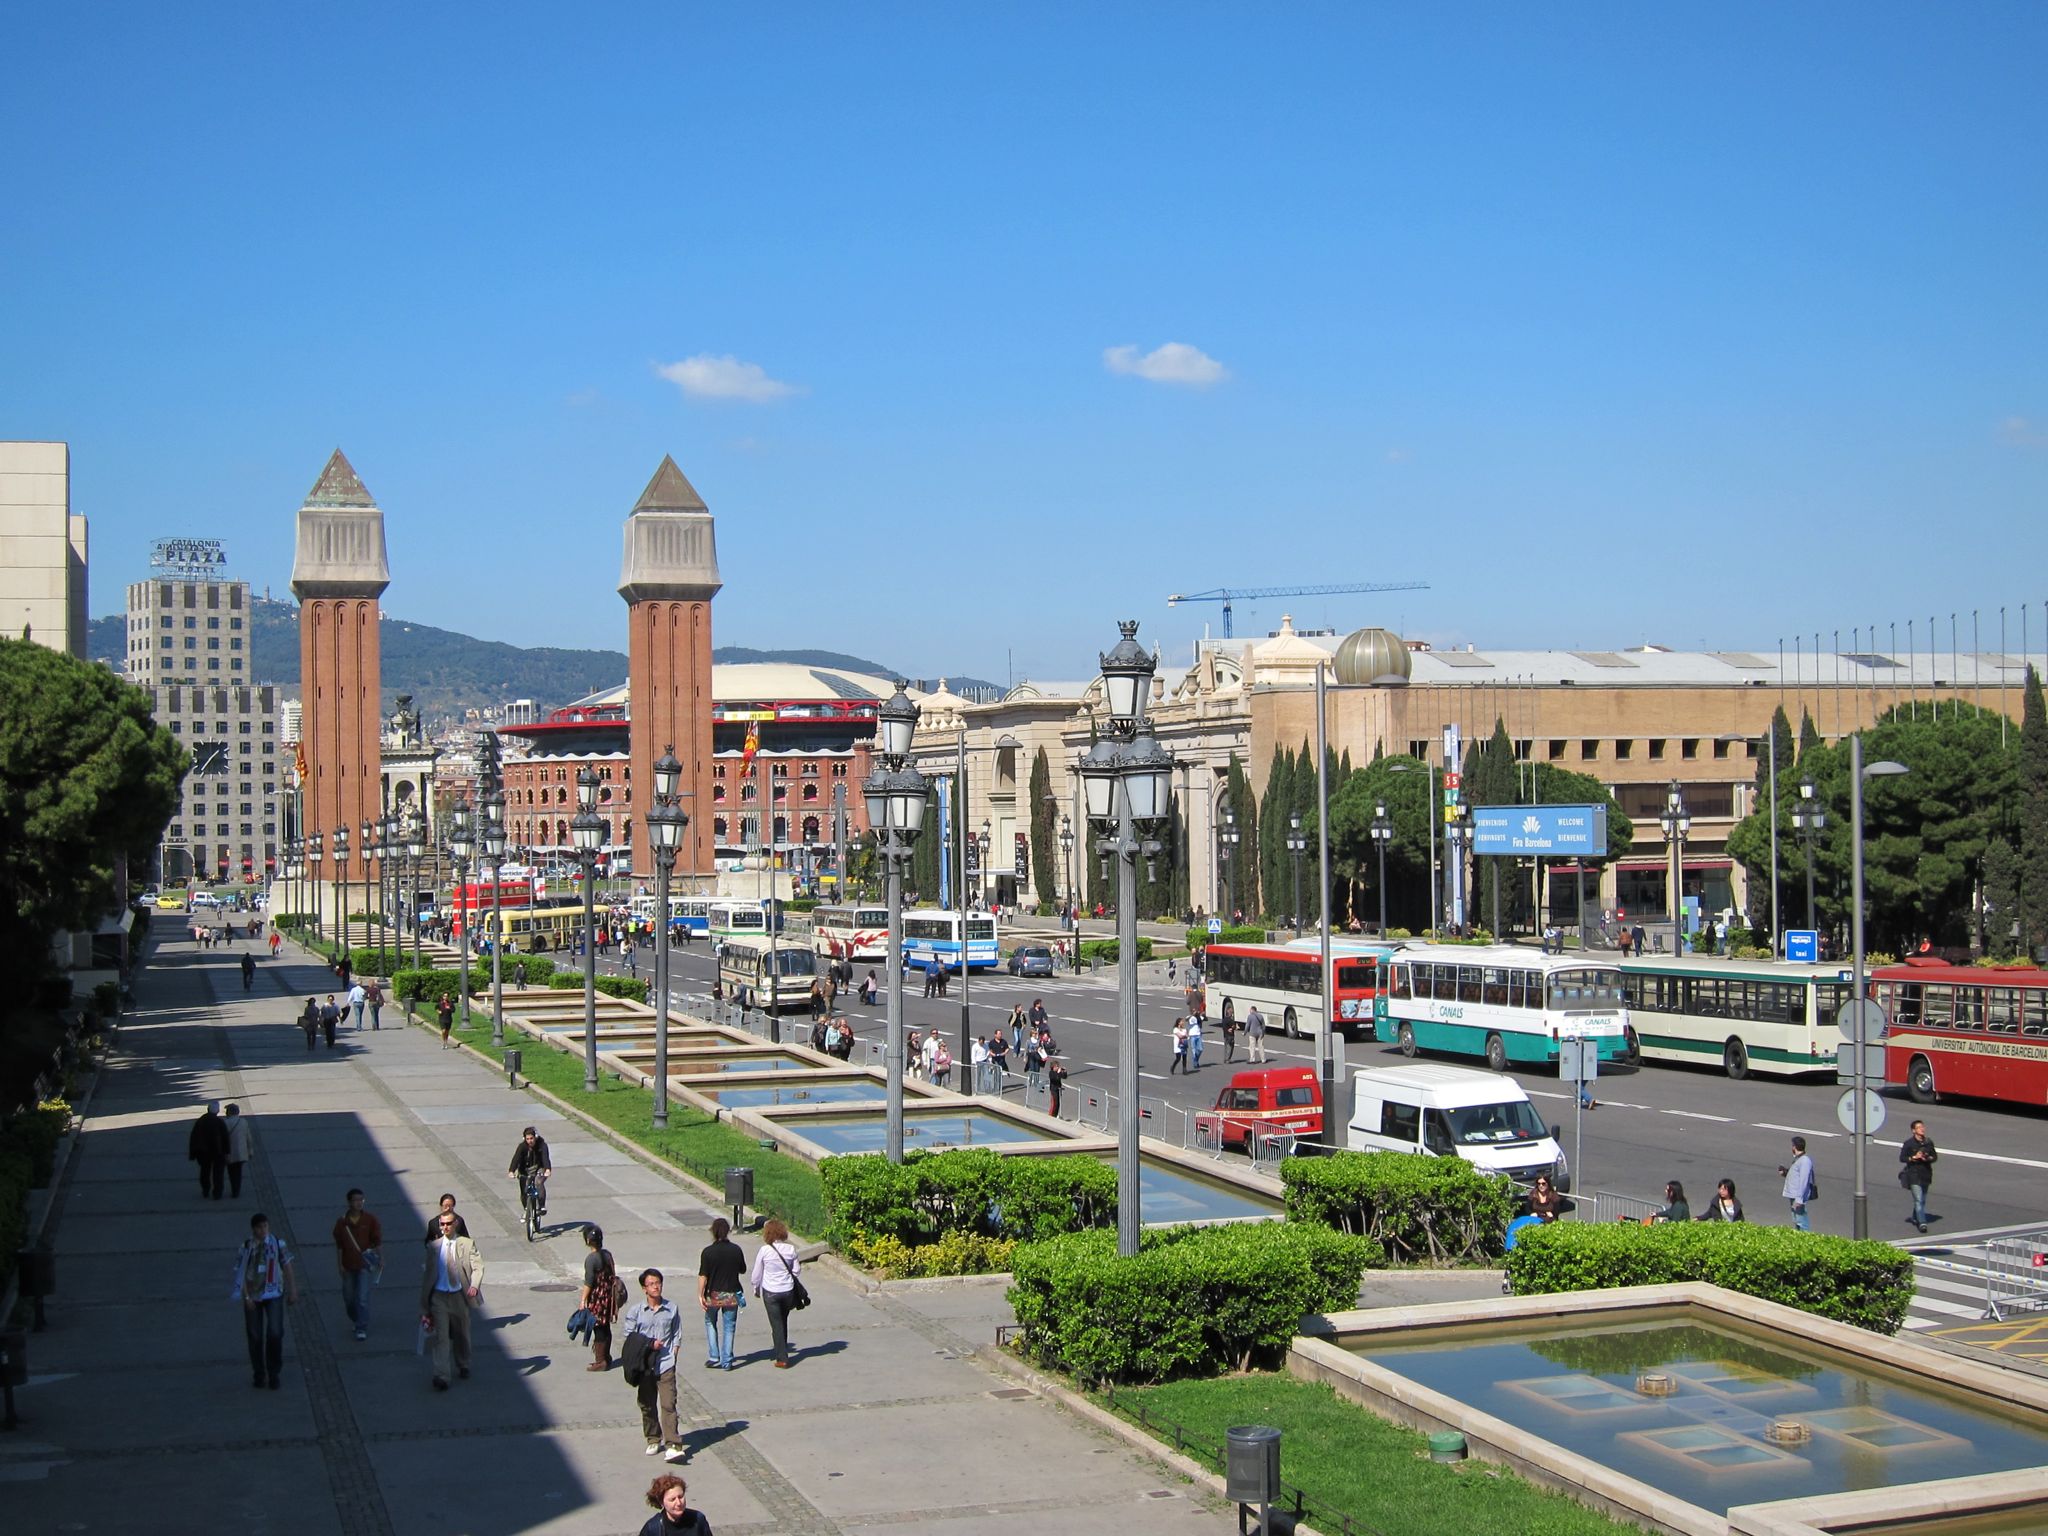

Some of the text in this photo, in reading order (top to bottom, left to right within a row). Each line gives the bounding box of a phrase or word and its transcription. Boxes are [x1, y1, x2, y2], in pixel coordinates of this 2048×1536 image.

[166, 551, 226, 563] PLAZA
[1451, 734, 1457, 746] 3
[1452, 776, 1458, 785] 5
[1557, 818, 1584, 826] WELCOME
[1512, 837, 1552, 848] Fira Barcelona
[1557, 834, 1587, 842] BIENVENUE
[1439, 1006, 1464, 1018] CANALS
[1931, 1038, 1966, 1051] UNIVERSITAT
[2002, 1045, 2011, 1056] DE
[2011, 1047, 2048, 1060] BARCELONA
